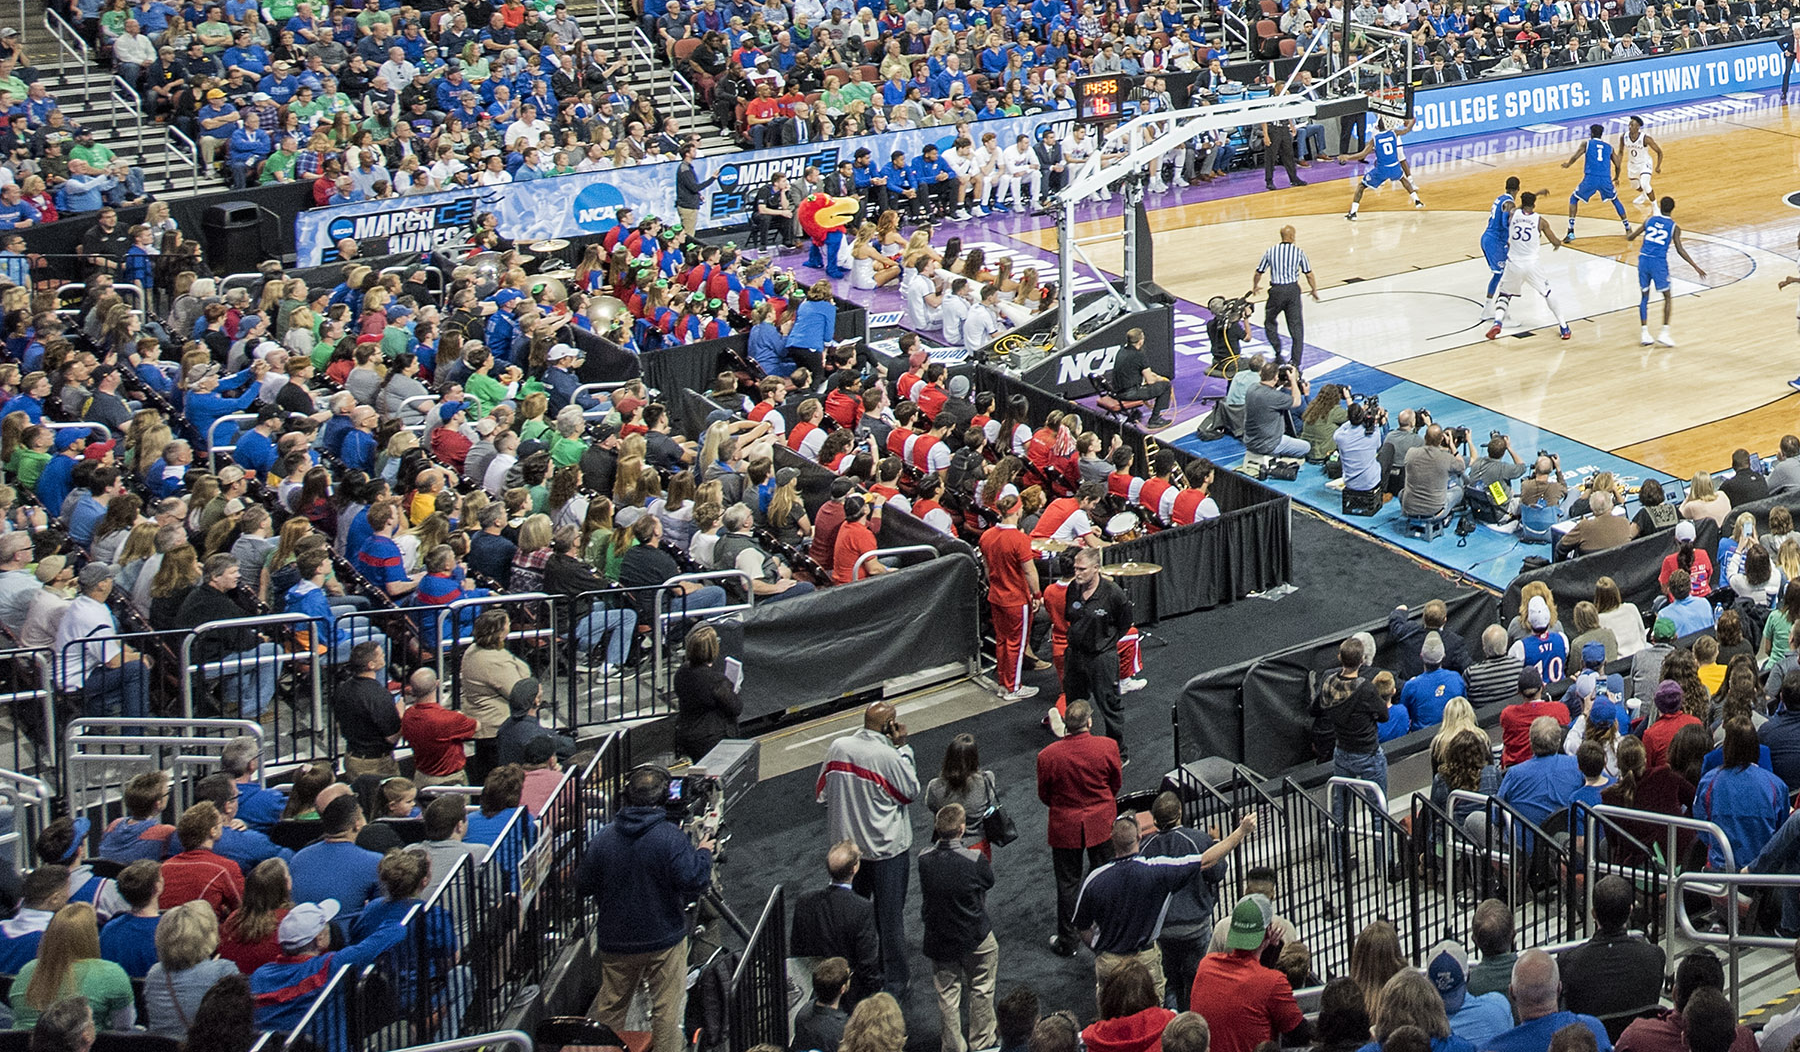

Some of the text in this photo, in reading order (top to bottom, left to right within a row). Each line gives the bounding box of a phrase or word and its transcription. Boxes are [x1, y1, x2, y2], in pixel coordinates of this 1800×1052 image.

[1085, 80, 1118, 96] 14:35
[1413, 93, 1500, 133] COLLEGE
[1505, 81, 1591, 119] SPORTS:
[1601, 76, 1614, 102] A
[1618, 64, 1700, 99] PATHWAY
[1705, 60, 1729, 86] TO
[1095, 98, 1110, 116] 16
[1382, 142, 1394, 155] 0
[1597, 148, 1603, 162] 1
[1630, 149, 1638, 158] 0
[354, 208, 436, 239] MARCH
[1511, 226, 1532, 242] 35
[1645, 226, 1669, 246] 22
[1058, 345, 1121, 385] NCA
